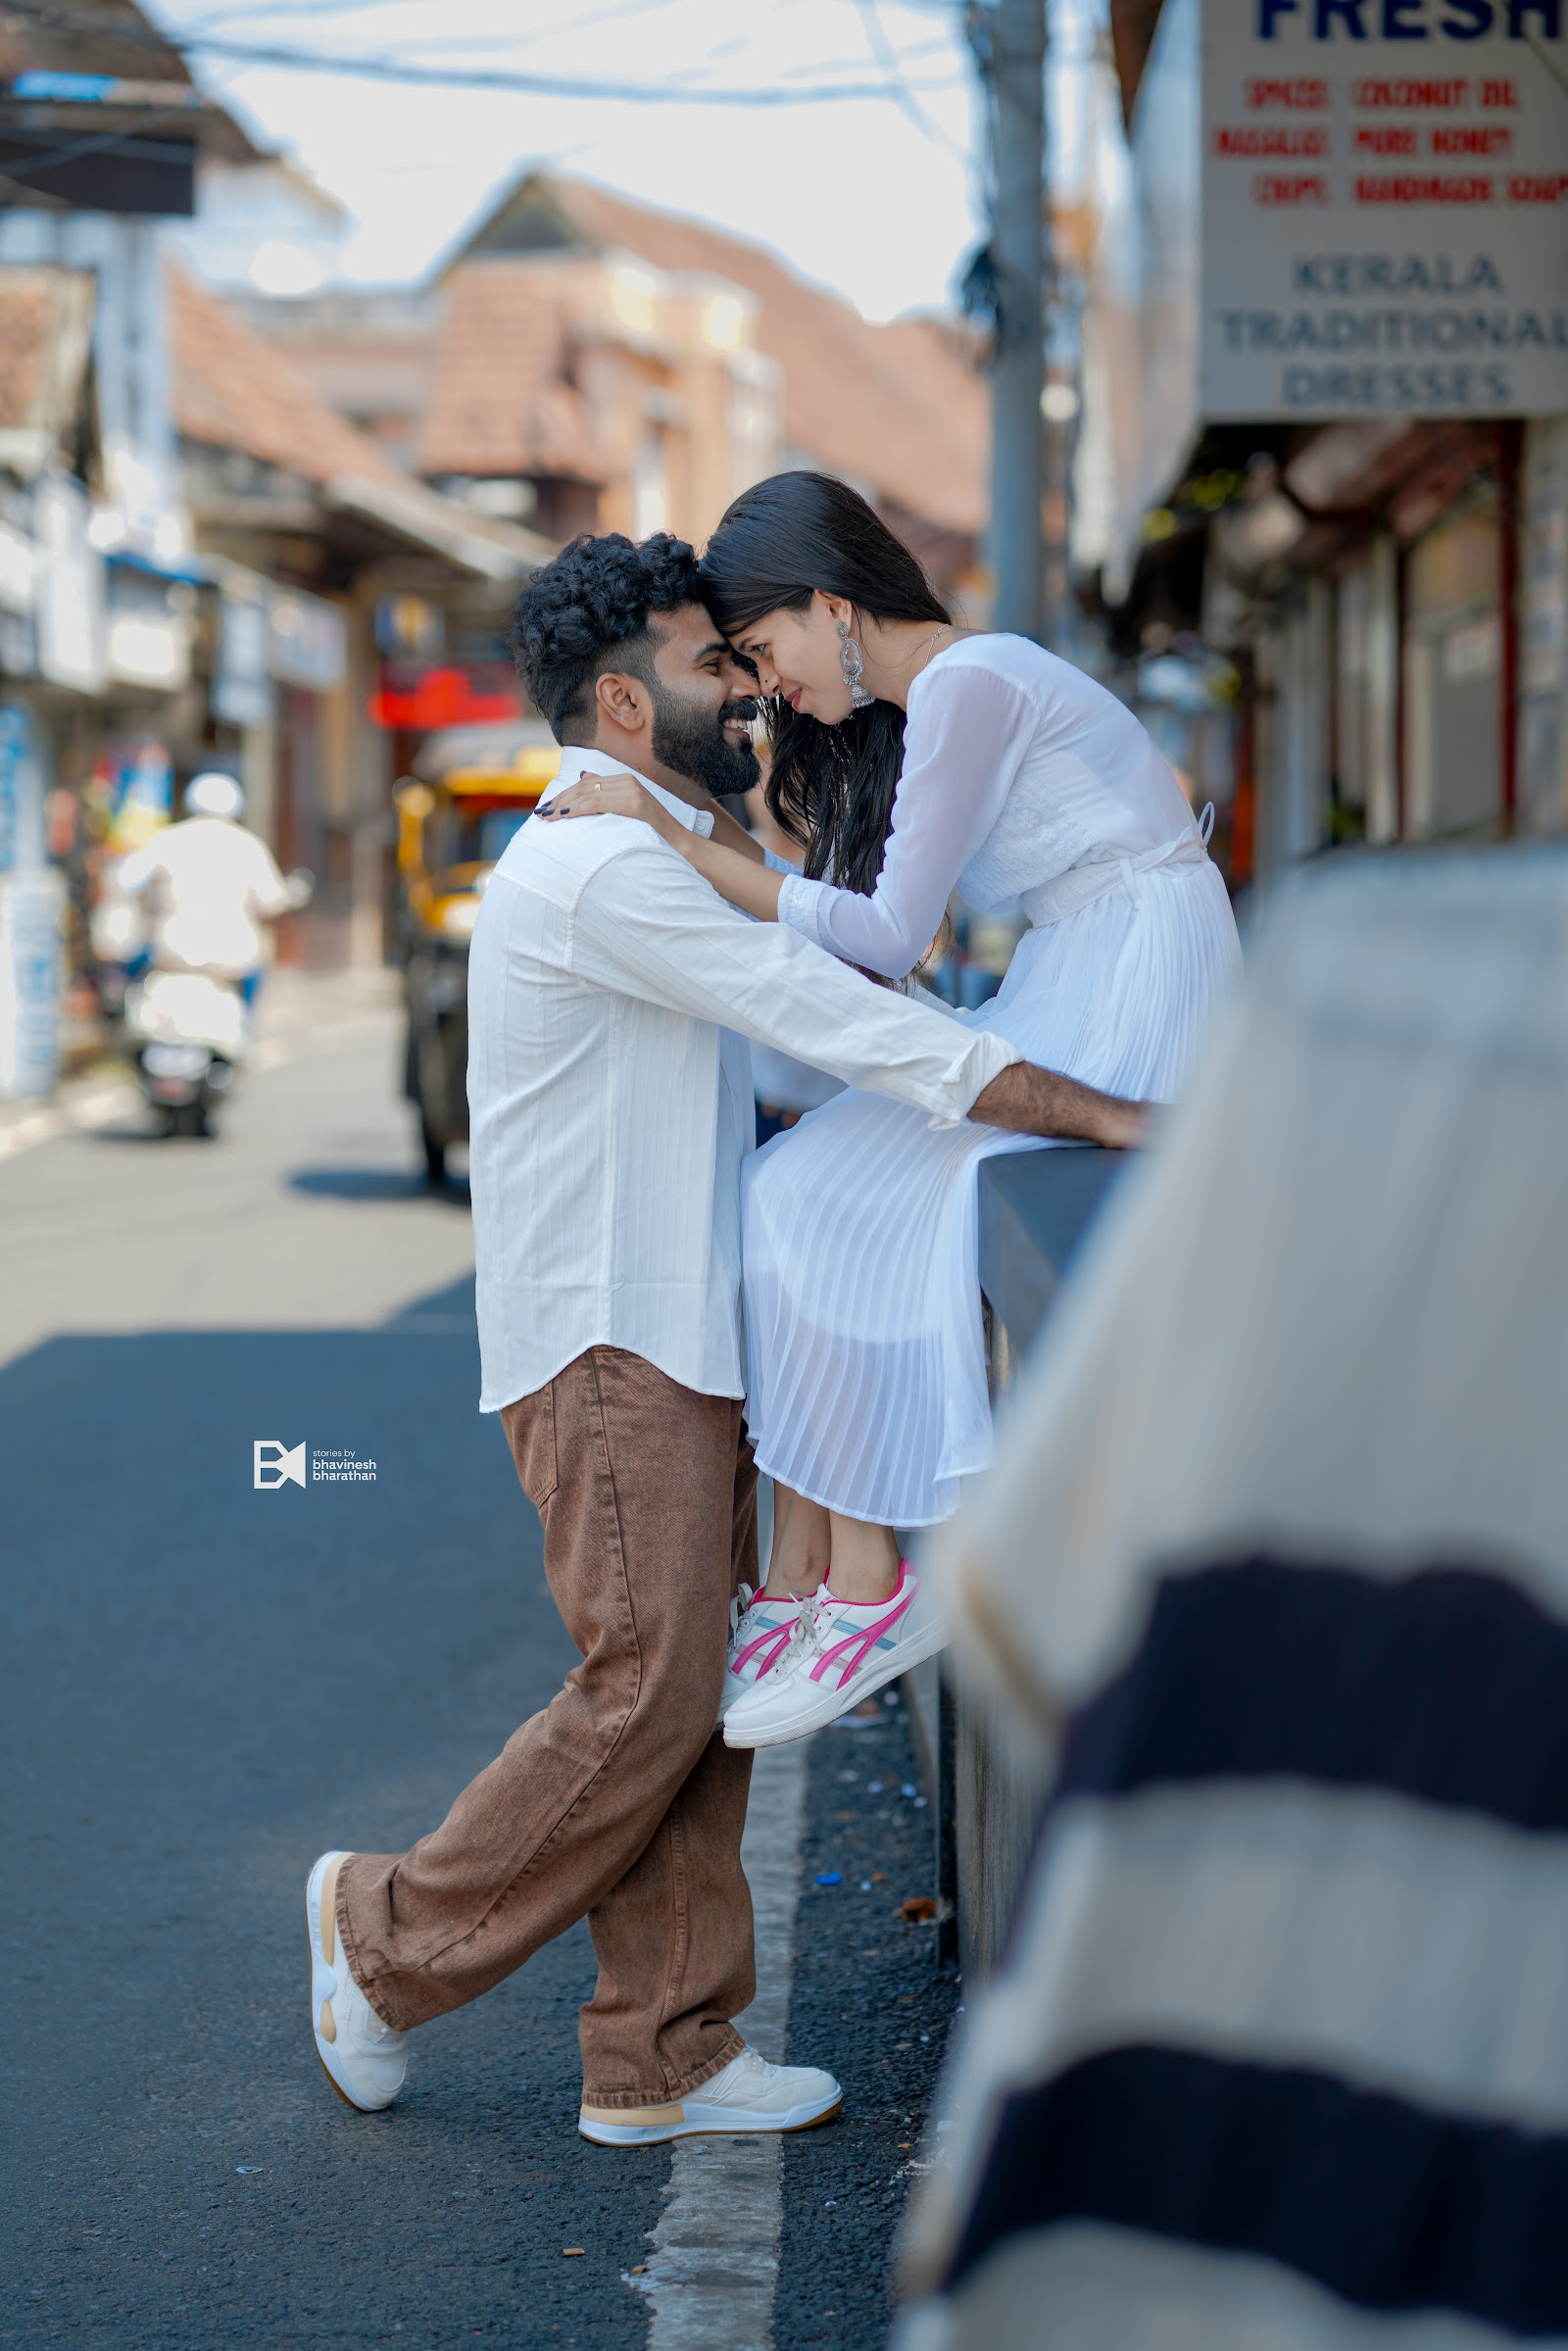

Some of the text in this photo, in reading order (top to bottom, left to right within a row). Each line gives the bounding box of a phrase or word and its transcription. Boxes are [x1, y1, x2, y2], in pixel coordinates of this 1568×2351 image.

[1258, 0, 1562, 40] FRESH
[1353, 78, 1519, 110] COCONUT OIL
[1354, 127, 1513, 158] PURE HONEY
[1354, 176, 1494, 205] HANDMADE
[1294, 255, 1502, 294] KERALA
[1218, 310, 1568, 351] TRADITIONAL
[1283, 364, 1510, 406] DRESSES
